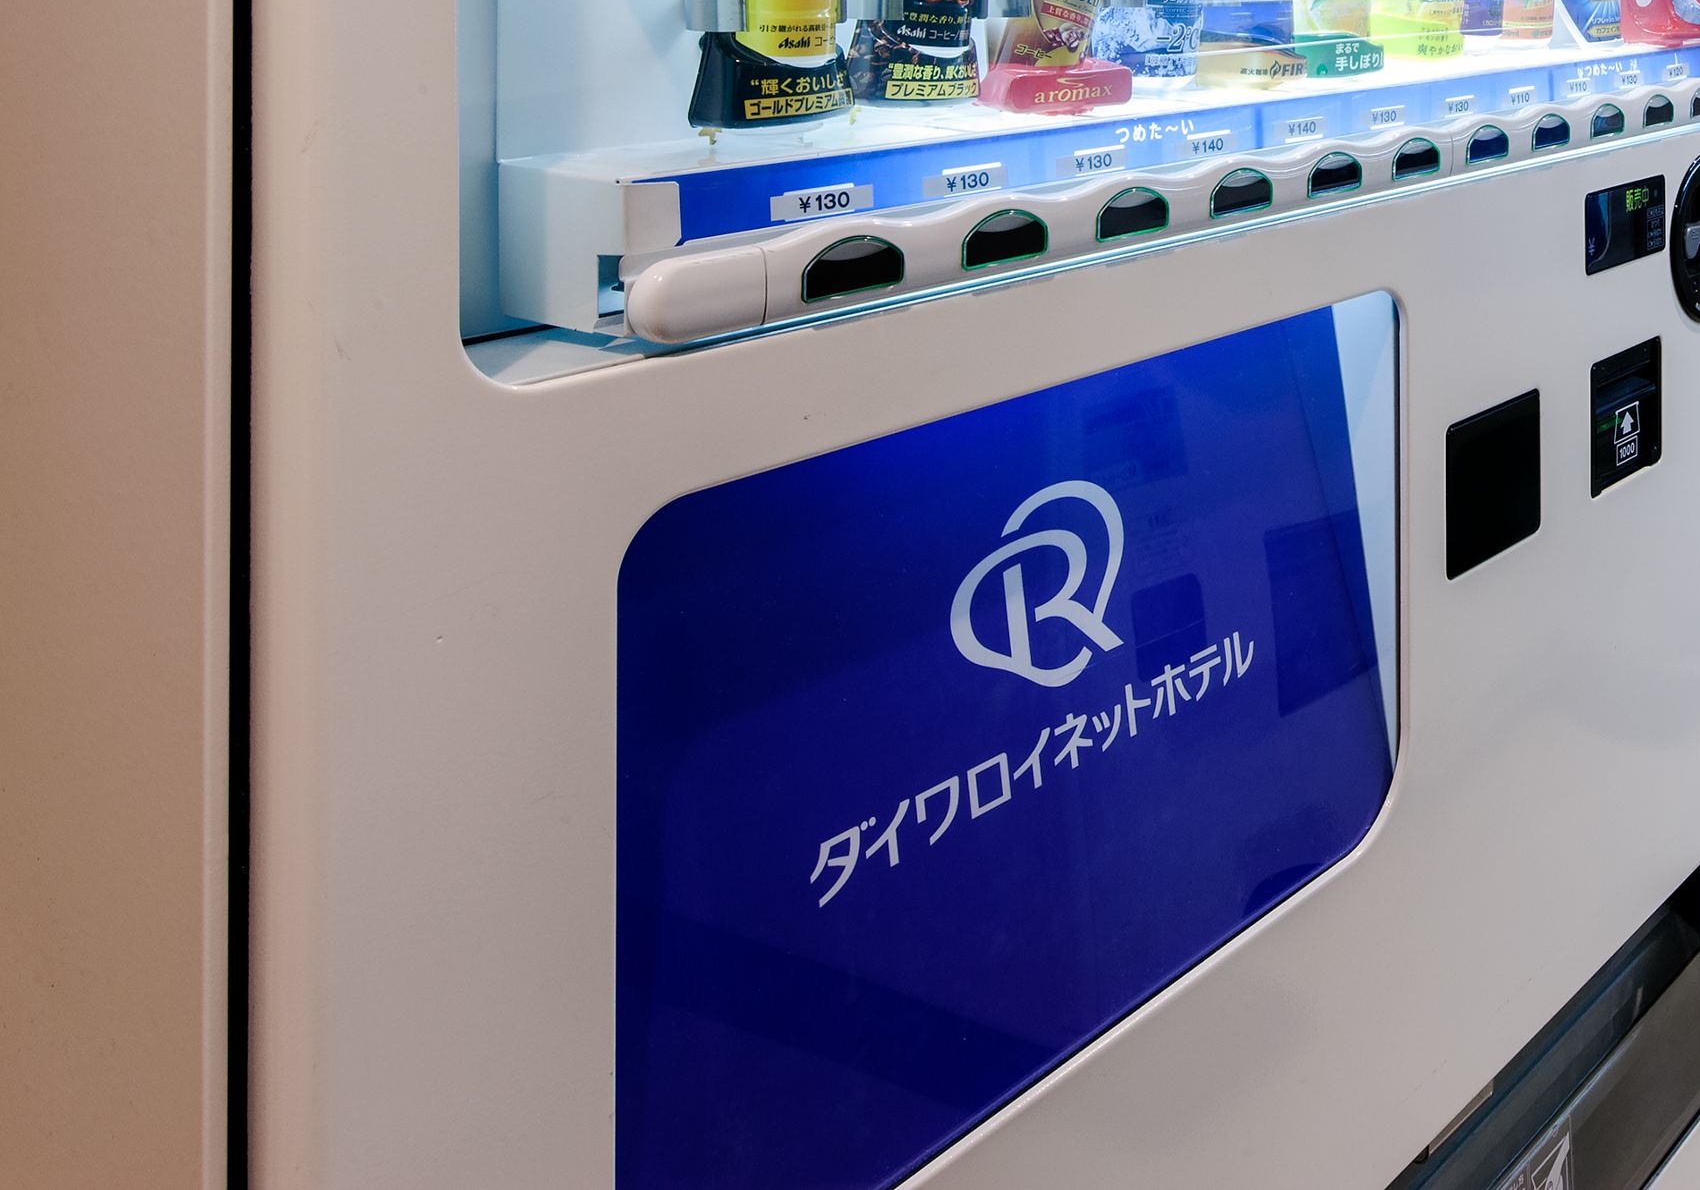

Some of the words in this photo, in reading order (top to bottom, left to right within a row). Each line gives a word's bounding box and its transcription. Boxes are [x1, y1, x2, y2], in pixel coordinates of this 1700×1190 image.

[897, 25, 926, 39] Asahi
[778, 37, 810, 49] Asahi
[1014, 43, 1052, 59] コーヒー
[1335, 43, 1359, 54] まるで
[1668, 66, 1684, 77] ¥120
[1569, 81, 1587, 92] ¥110
[1621, 74, 1638, 86] ¥130
[891, 81, 977, 97] プレミアムブラック
[1034, 84, 1113, 104] aromax
[1510, 90, 1530, 105] ¥110
[1448, 99, 1470, 114] ¥130
[1371, 109, 1397, 125] ¥130
[1115, 119, 1195, 143] つめた～い
[1288, 120, 1317, 137] ¥140
[1191, 136, 1224, 155] ¥140
[1074, 152, 1114, 173] ¥130
[946, 171, 990, 193] ¥130
[799, 190, 851, 214] ¥130
[1625, 187, 1650, 213] 販売中
[1619, 442, 1636, 459] 1000
[810, 630, 1255, 909] ダイワロイネットホテル
